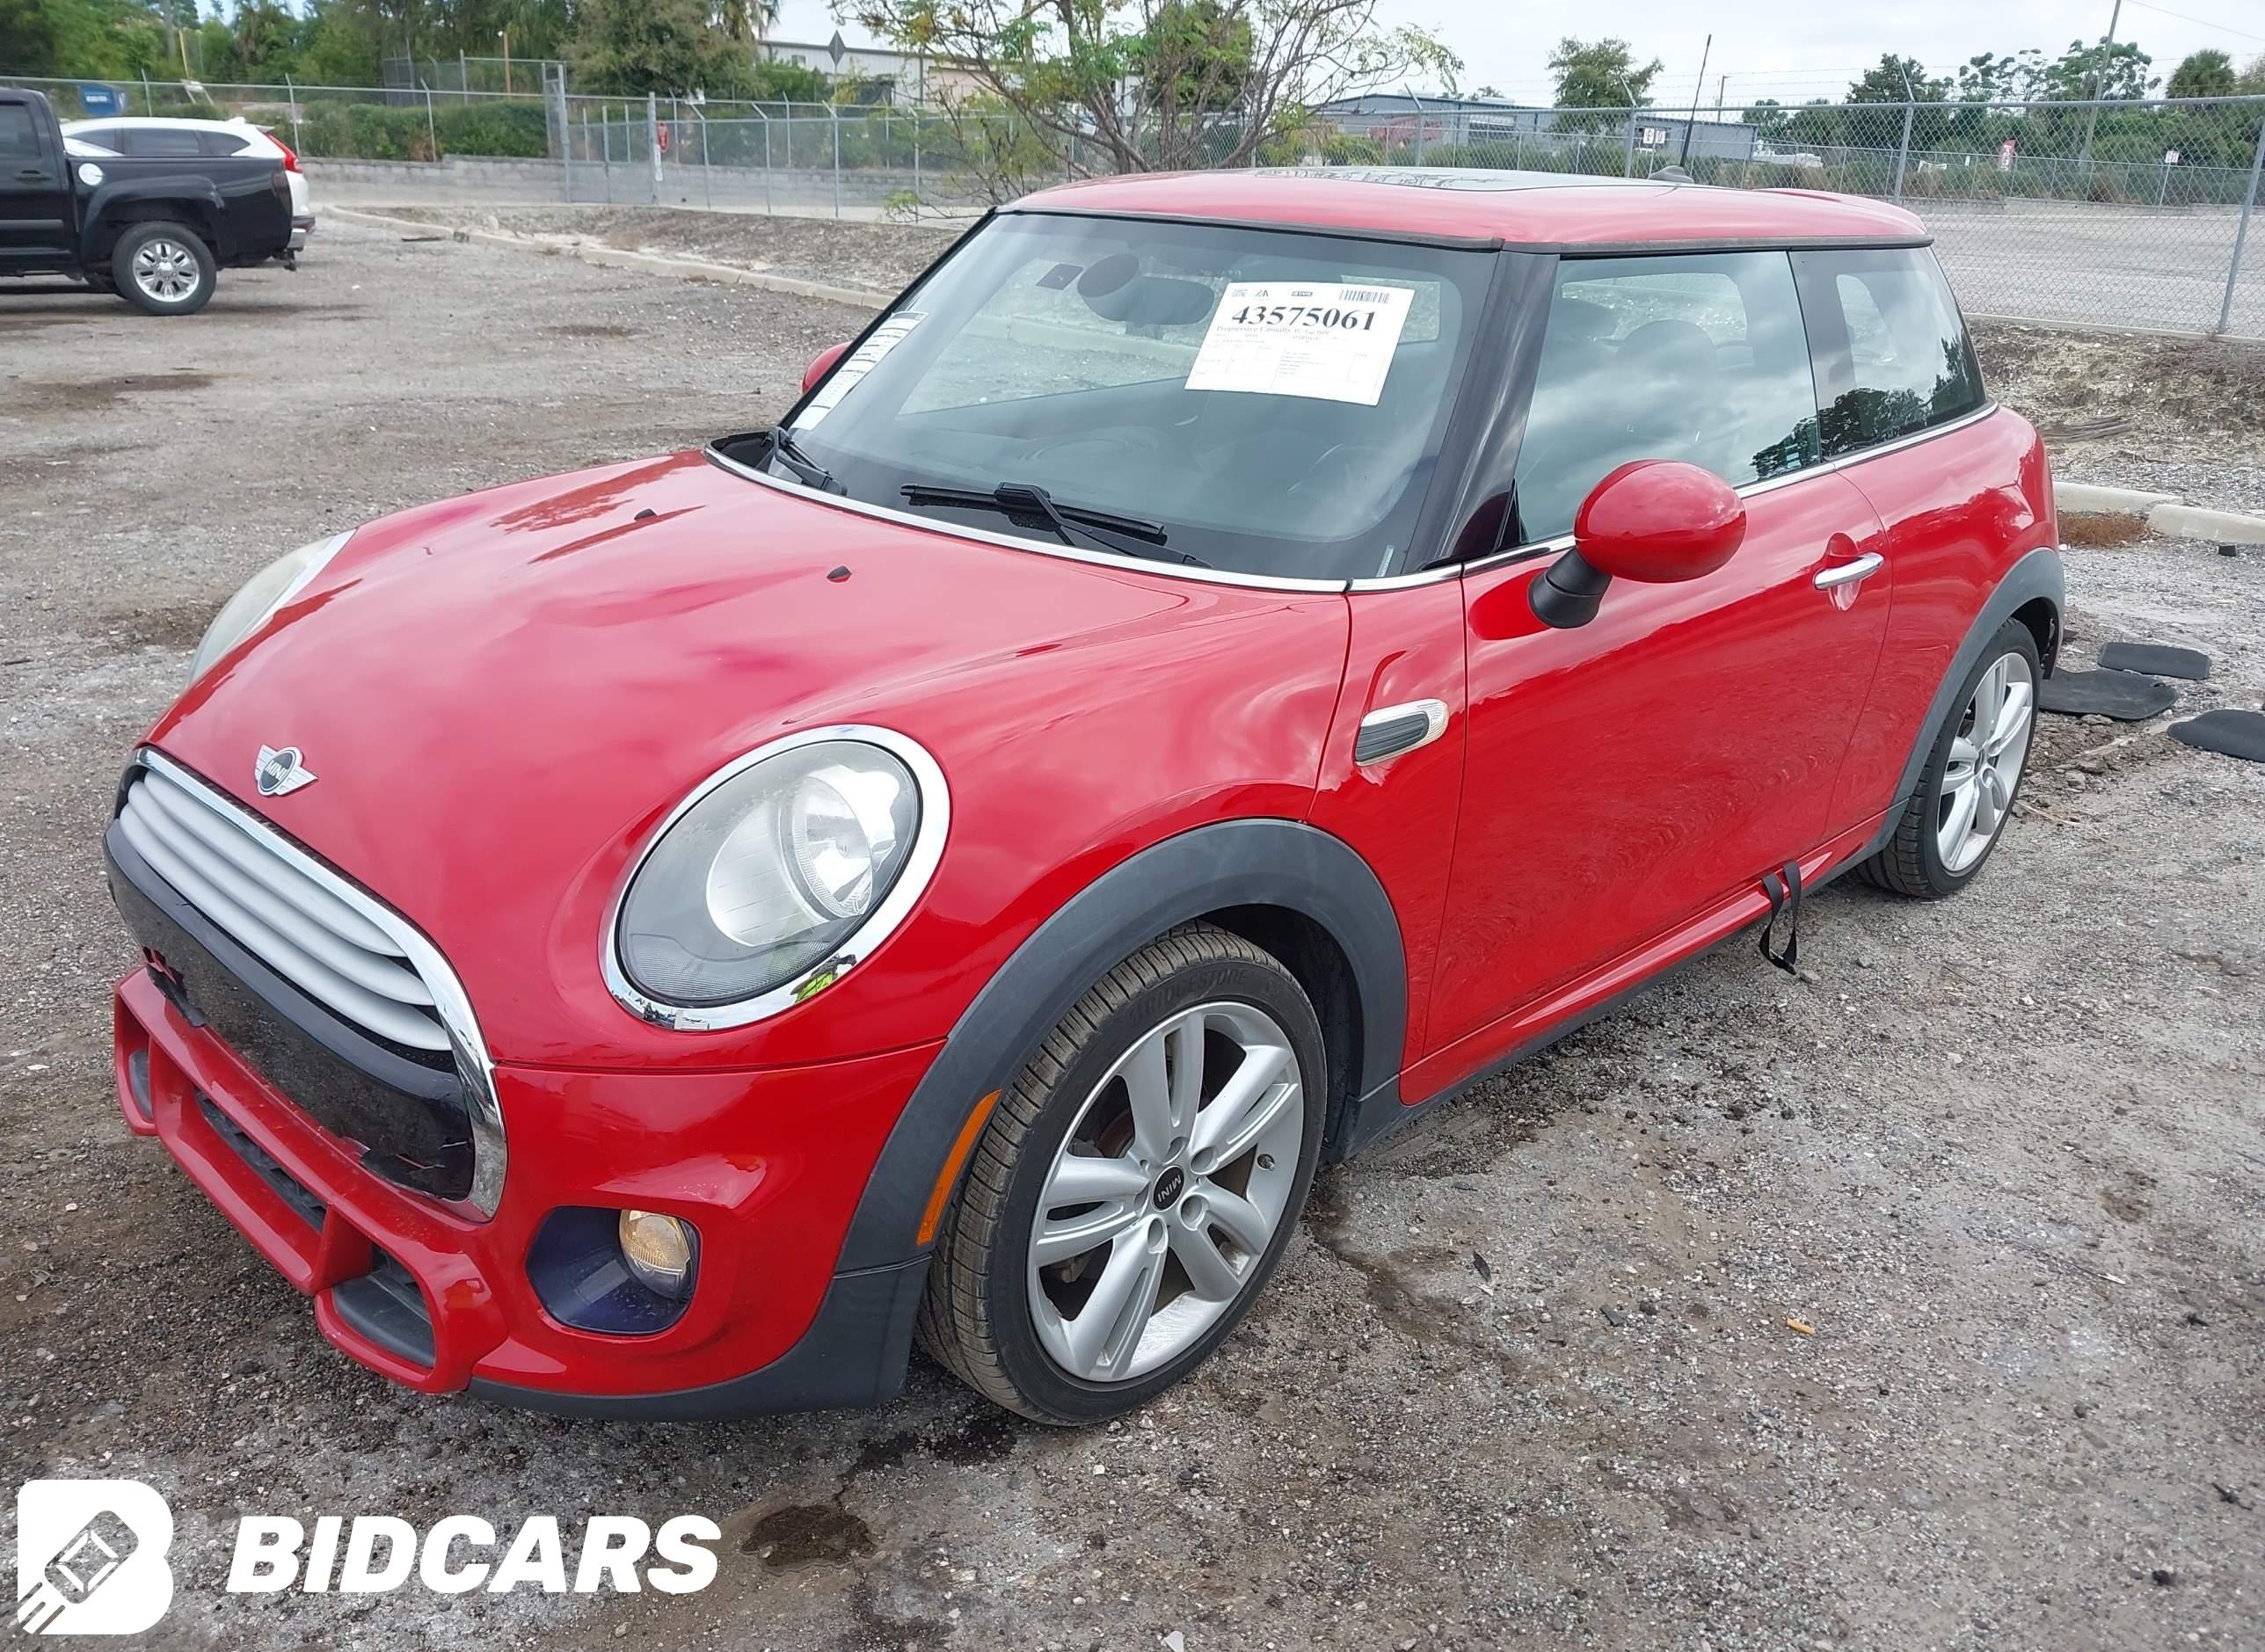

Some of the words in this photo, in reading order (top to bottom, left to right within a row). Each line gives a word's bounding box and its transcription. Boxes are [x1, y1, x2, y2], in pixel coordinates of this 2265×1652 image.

[1231, 305, 1377, 331] 43575061
[264, 760, 288, 781] MINI
[1126, 968, 1248, 1023] BRIDGESTONE
[1156, 1175, 1182, 1203] MINI
